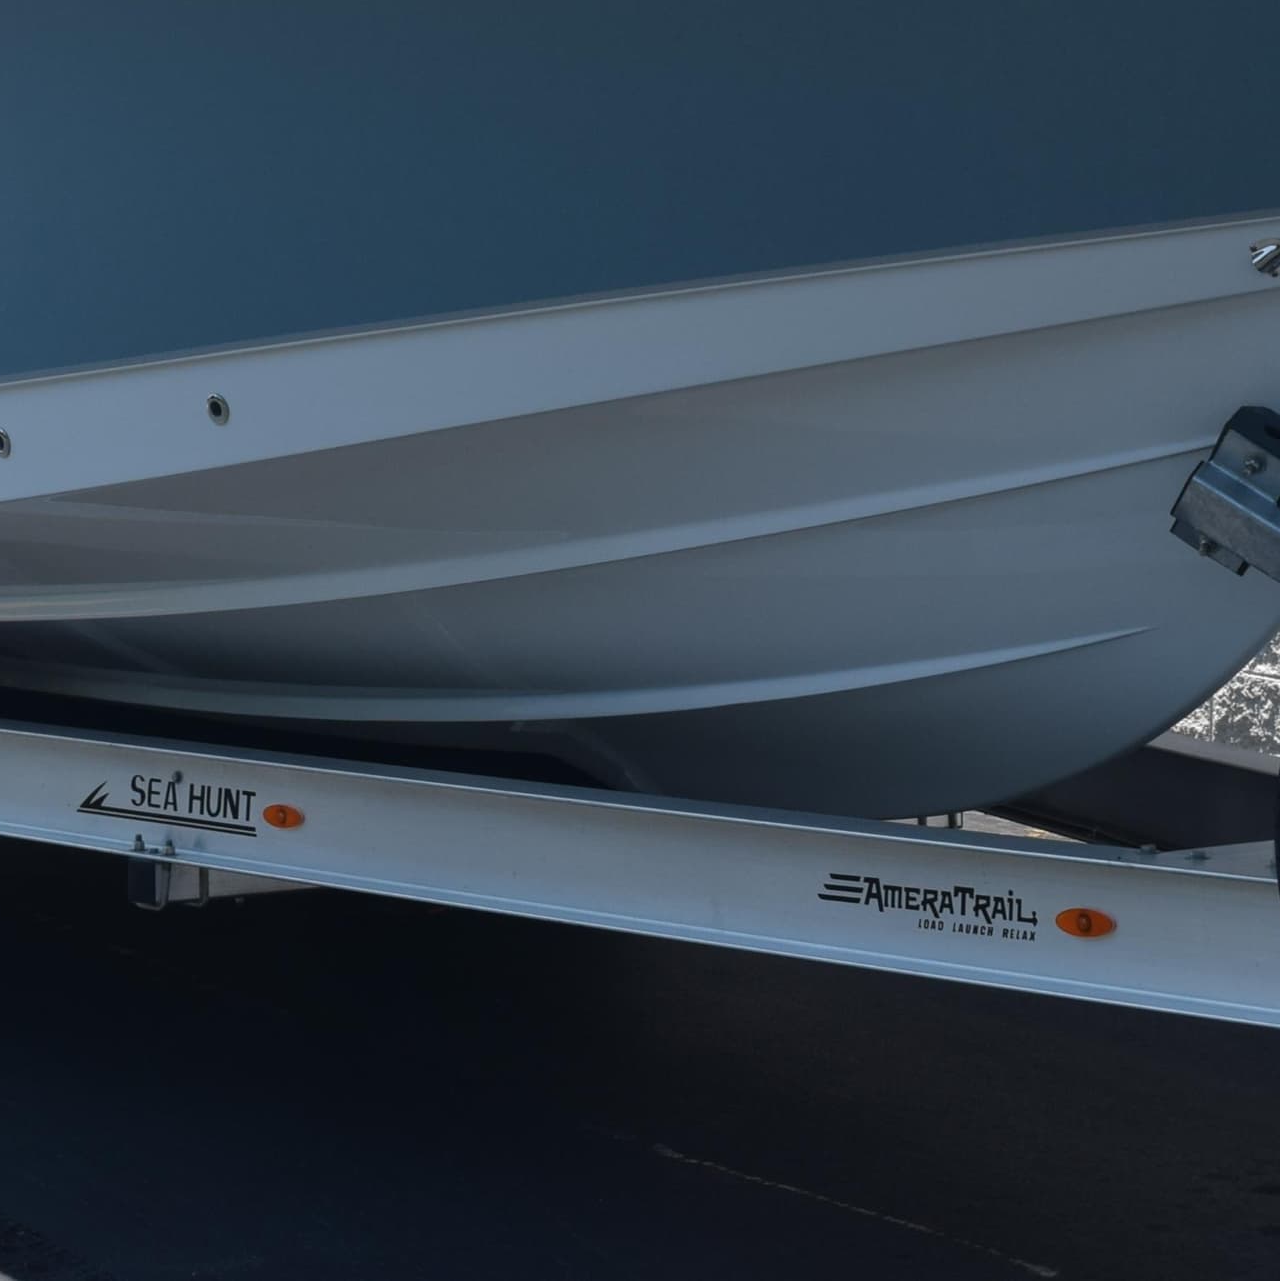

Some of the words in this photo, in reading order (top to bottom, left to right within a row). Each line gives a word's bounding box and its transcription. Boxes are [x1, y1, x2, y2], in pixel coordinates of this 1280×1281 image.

[130, 774, 178, 812] SEA
[187, 782, 257, 822] HUNT
[918, 918, 945, 932] LOAD
[952, 922, 994, 937] LAUNCH
[1002, 927, 1036, 942] RELAX
